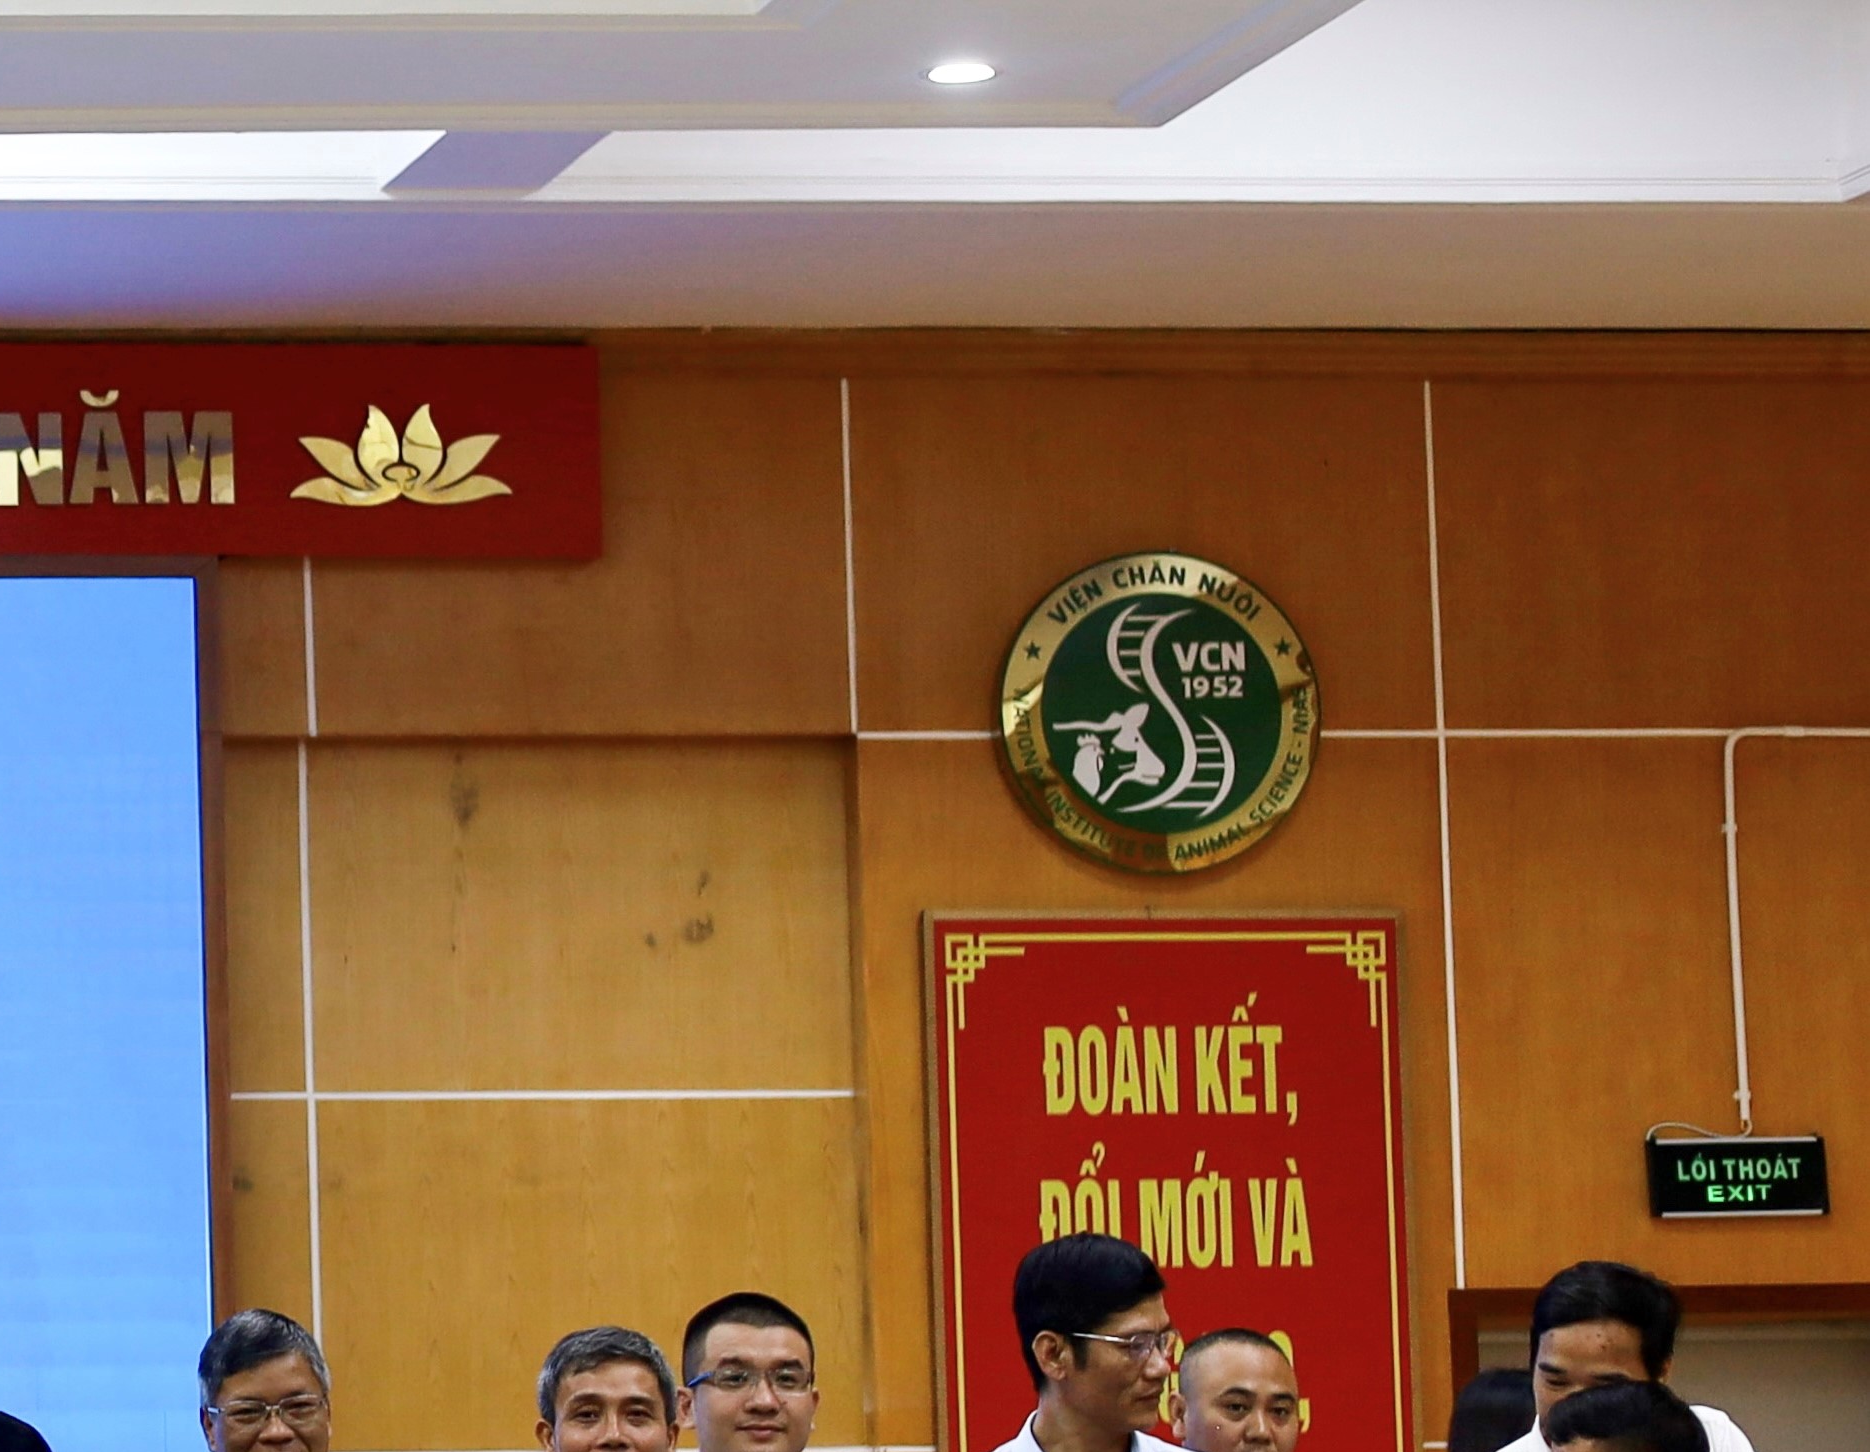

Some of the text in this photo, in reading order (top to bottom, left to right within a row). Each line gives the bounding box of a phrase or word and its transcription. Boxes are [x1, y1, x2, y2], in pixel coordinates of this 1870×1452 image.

[1171, 641, 1246, 672] VCN
[1181, 676, 1244, 699] 1952
[1173, 823, 1254, 862] ANIMAL
[1249, 754, 1304, 825] SCIENCE
[1042, 991, 1299, 1125] ĐOÀN KẾT,
[1722, 1153, 1802, 1181] THOÁT
[1039, 1141, 1314, 1269] ĐỔI MỚI VÀ
[1707, 1185, 1772, 1203] EXIT
